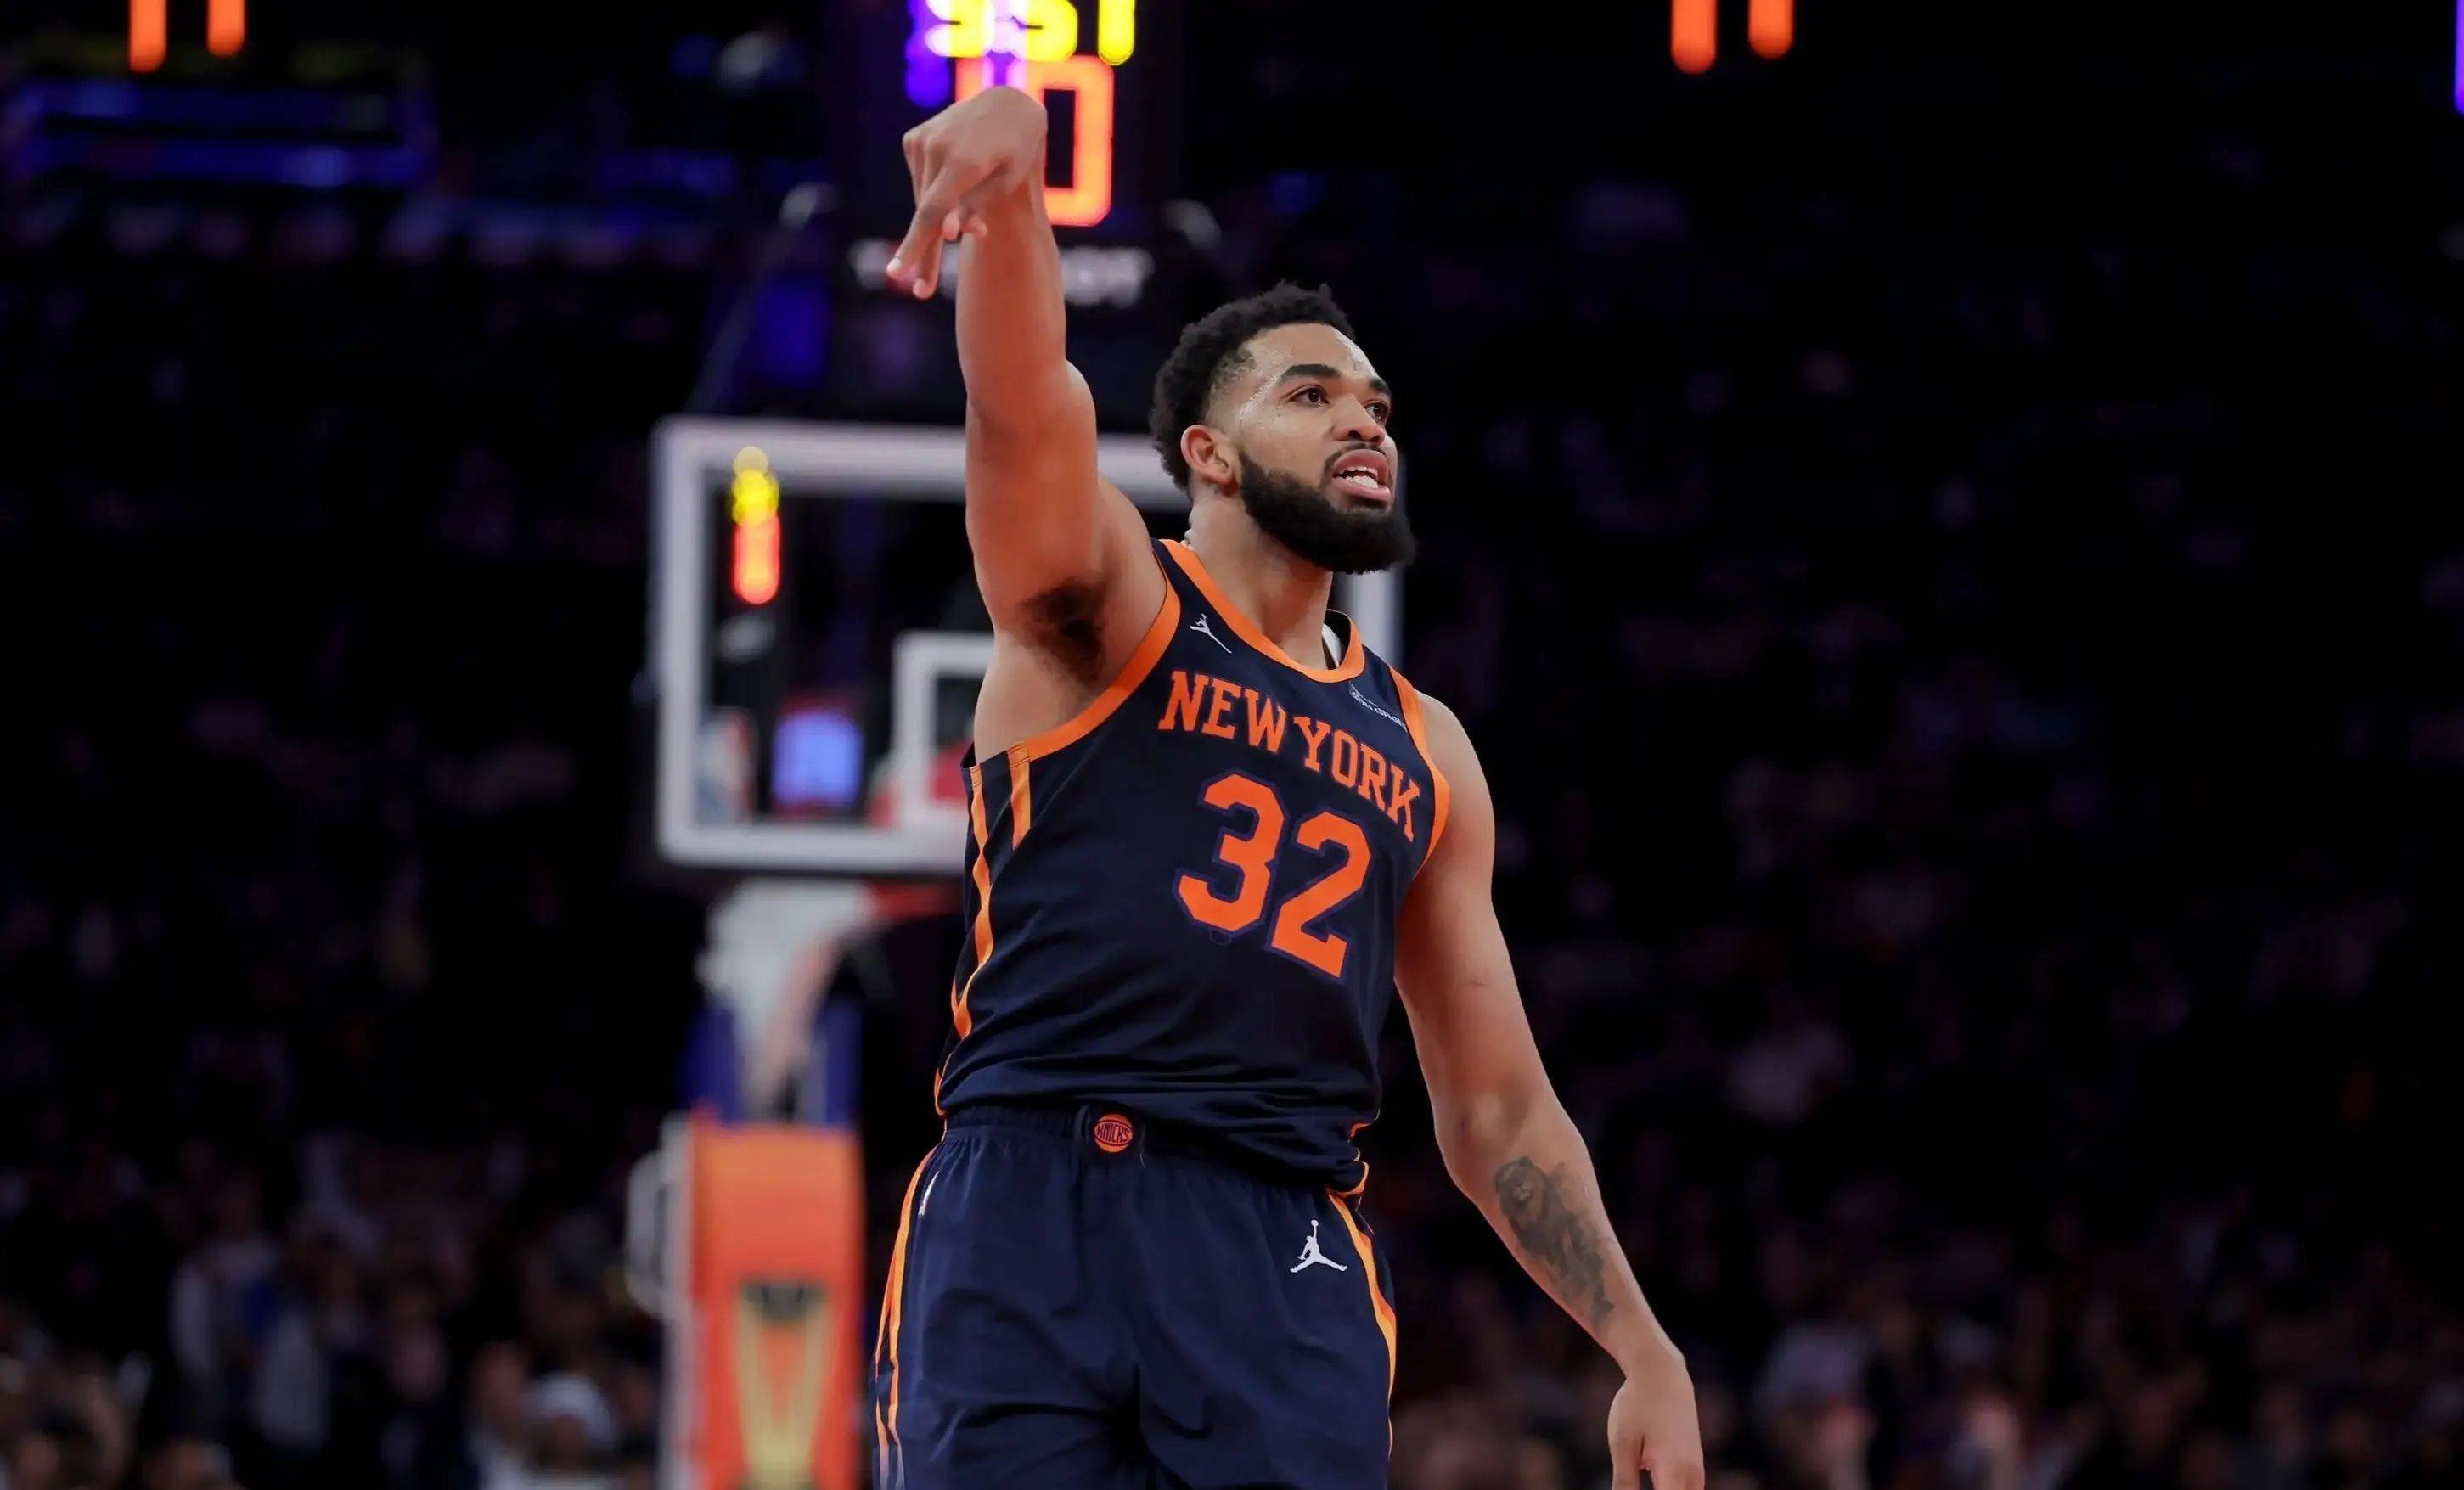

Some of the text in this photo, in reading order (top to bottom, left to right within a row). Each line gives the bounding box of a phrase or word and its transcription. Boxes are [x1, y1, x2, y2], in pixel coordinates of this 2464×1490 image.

[1157, 670, 1288, 754] NEW
[1292, 716, 1421, 843] YORK
[1175, 771, 1372, 981] 32
